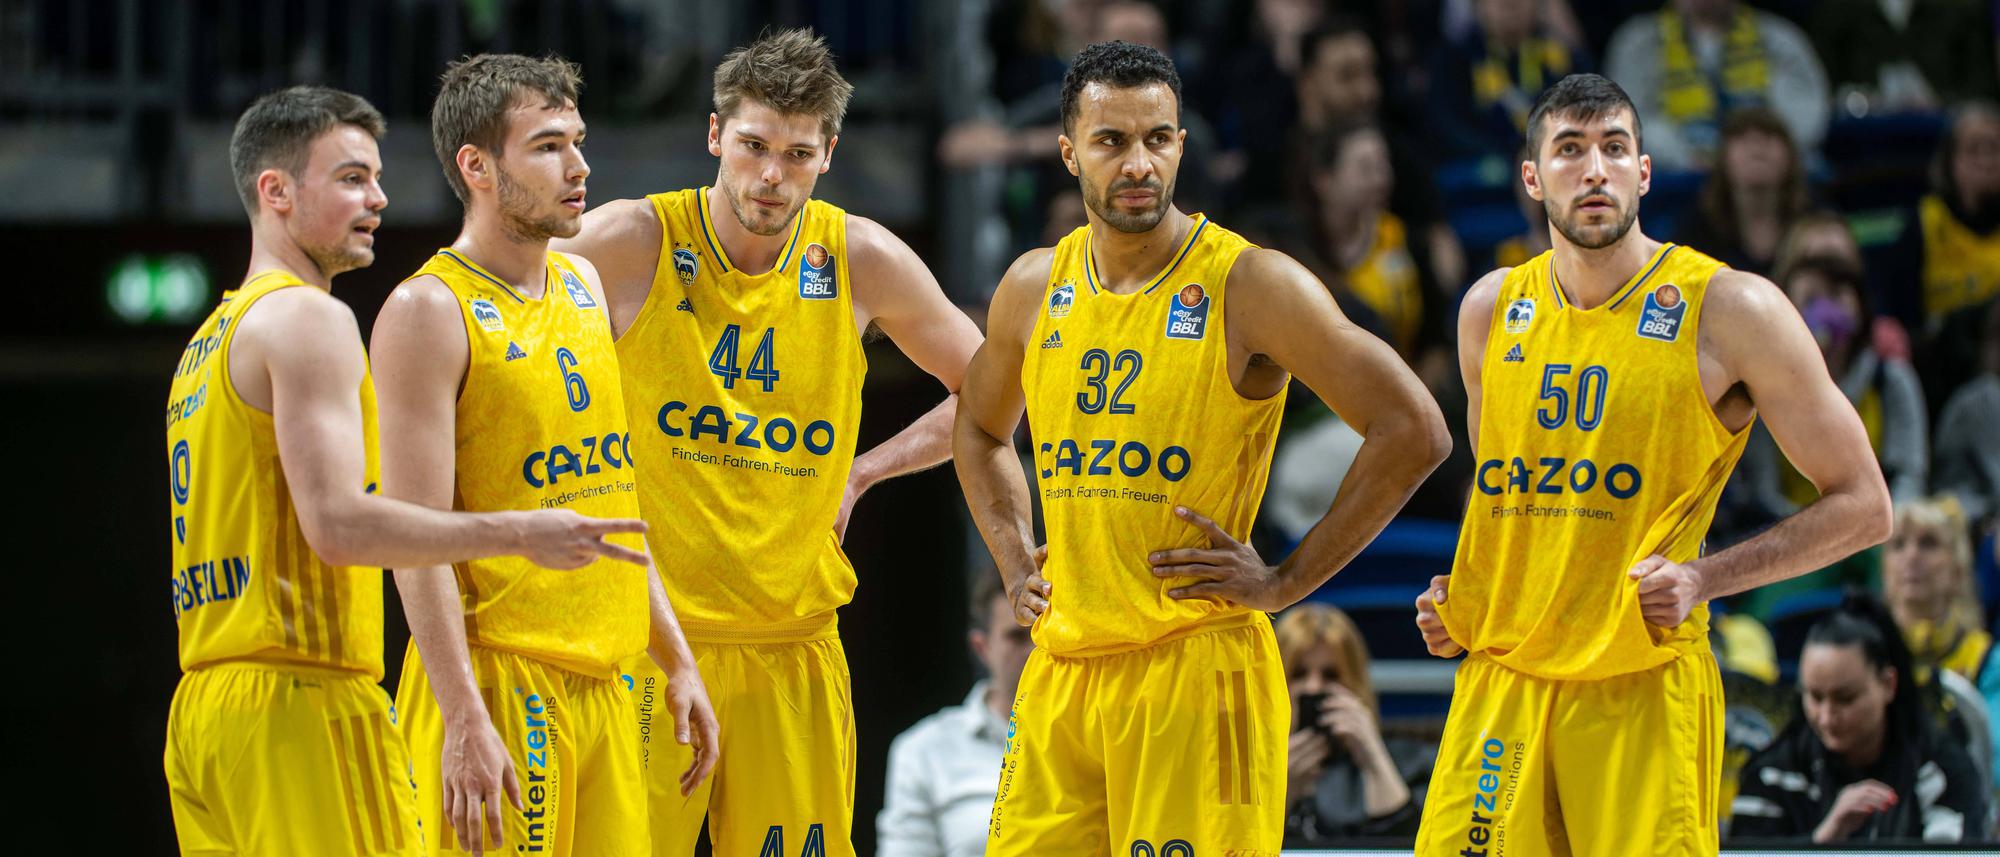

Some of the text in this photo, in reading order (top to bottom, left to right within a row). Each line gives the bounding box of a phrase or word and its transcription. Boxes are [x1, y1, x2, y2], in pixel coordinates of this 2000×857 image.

[803, 282, 832, 295] BBL
[709, 324, 780, 392] 44
[1170, 322, 1199, 335] BBL
[1642, 320, 1672, 337] BBL
[556, 347, 590, 412] 6
[1077, 348, 1143, 415] 32
[1537, 364, 1608, 432] 50
[657, 401, 835, 456] CAZOO
[672, 448, 819, 477] Finden. Fahren. Freuen.
[1040, 439, 1191, 482] CAZOO
[1477, 456, 1642, 499] CAZOO
[1077, 486, 1119, 499] Fahren.
[1122, 487, 1170, 504] Freuen.
[1570, 505, 1616, 521] reuen.
[638, 676, 655, 744] solutions
[518, 693, 547, 853] interzero
[994, 806, 1003, 838] zero
[1000, 759, 1017, 803] waste
[1459, 738, 1504, 857] terzero
[1505, 741, 1525, 811] solutions
